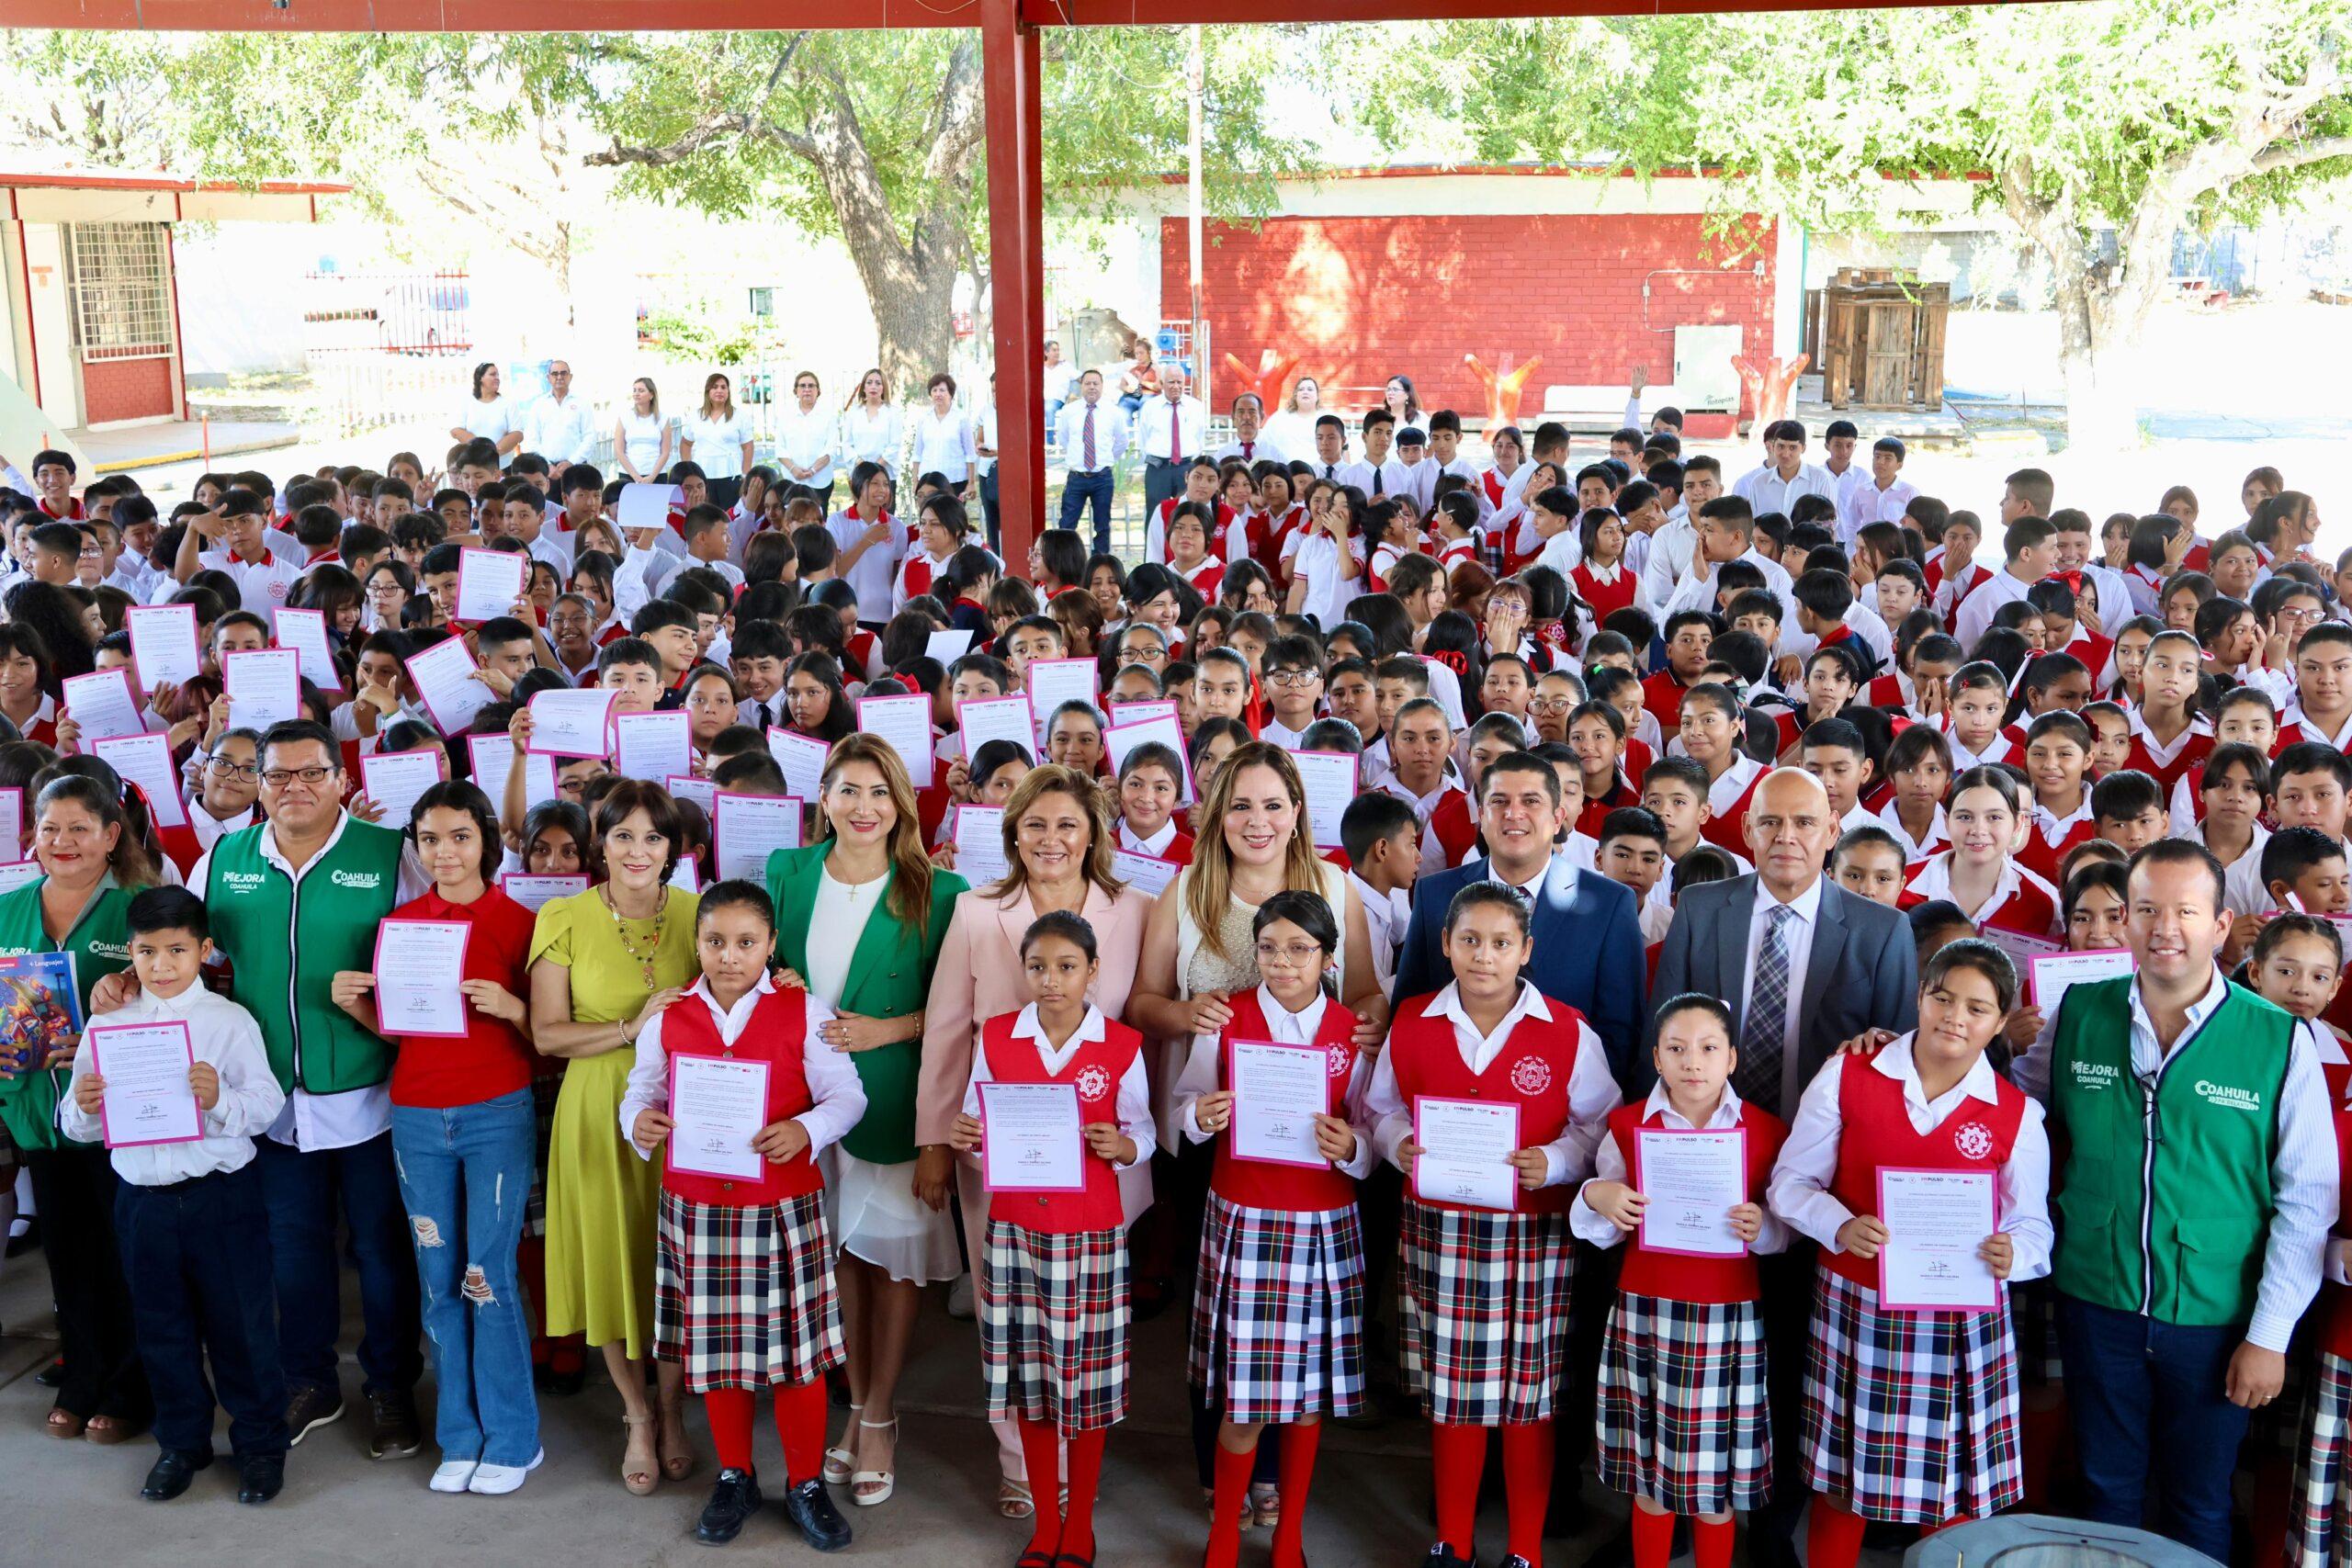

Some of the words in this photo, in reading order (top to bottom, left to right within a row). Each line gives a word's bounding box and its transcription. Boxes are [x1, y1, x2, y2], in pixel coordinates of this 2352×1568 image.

[222, 871, 266, 884] MEJORA
[331, 869, 380, 884] COAHUILA
[0, 946, 32, 956] EJORA
[2071, 1060, 2120, 1078] MEJORA
[2076, 1076, 2111, 1086] COAHUILA
[2195, 1080, 2260, 1103] COAHUILA
